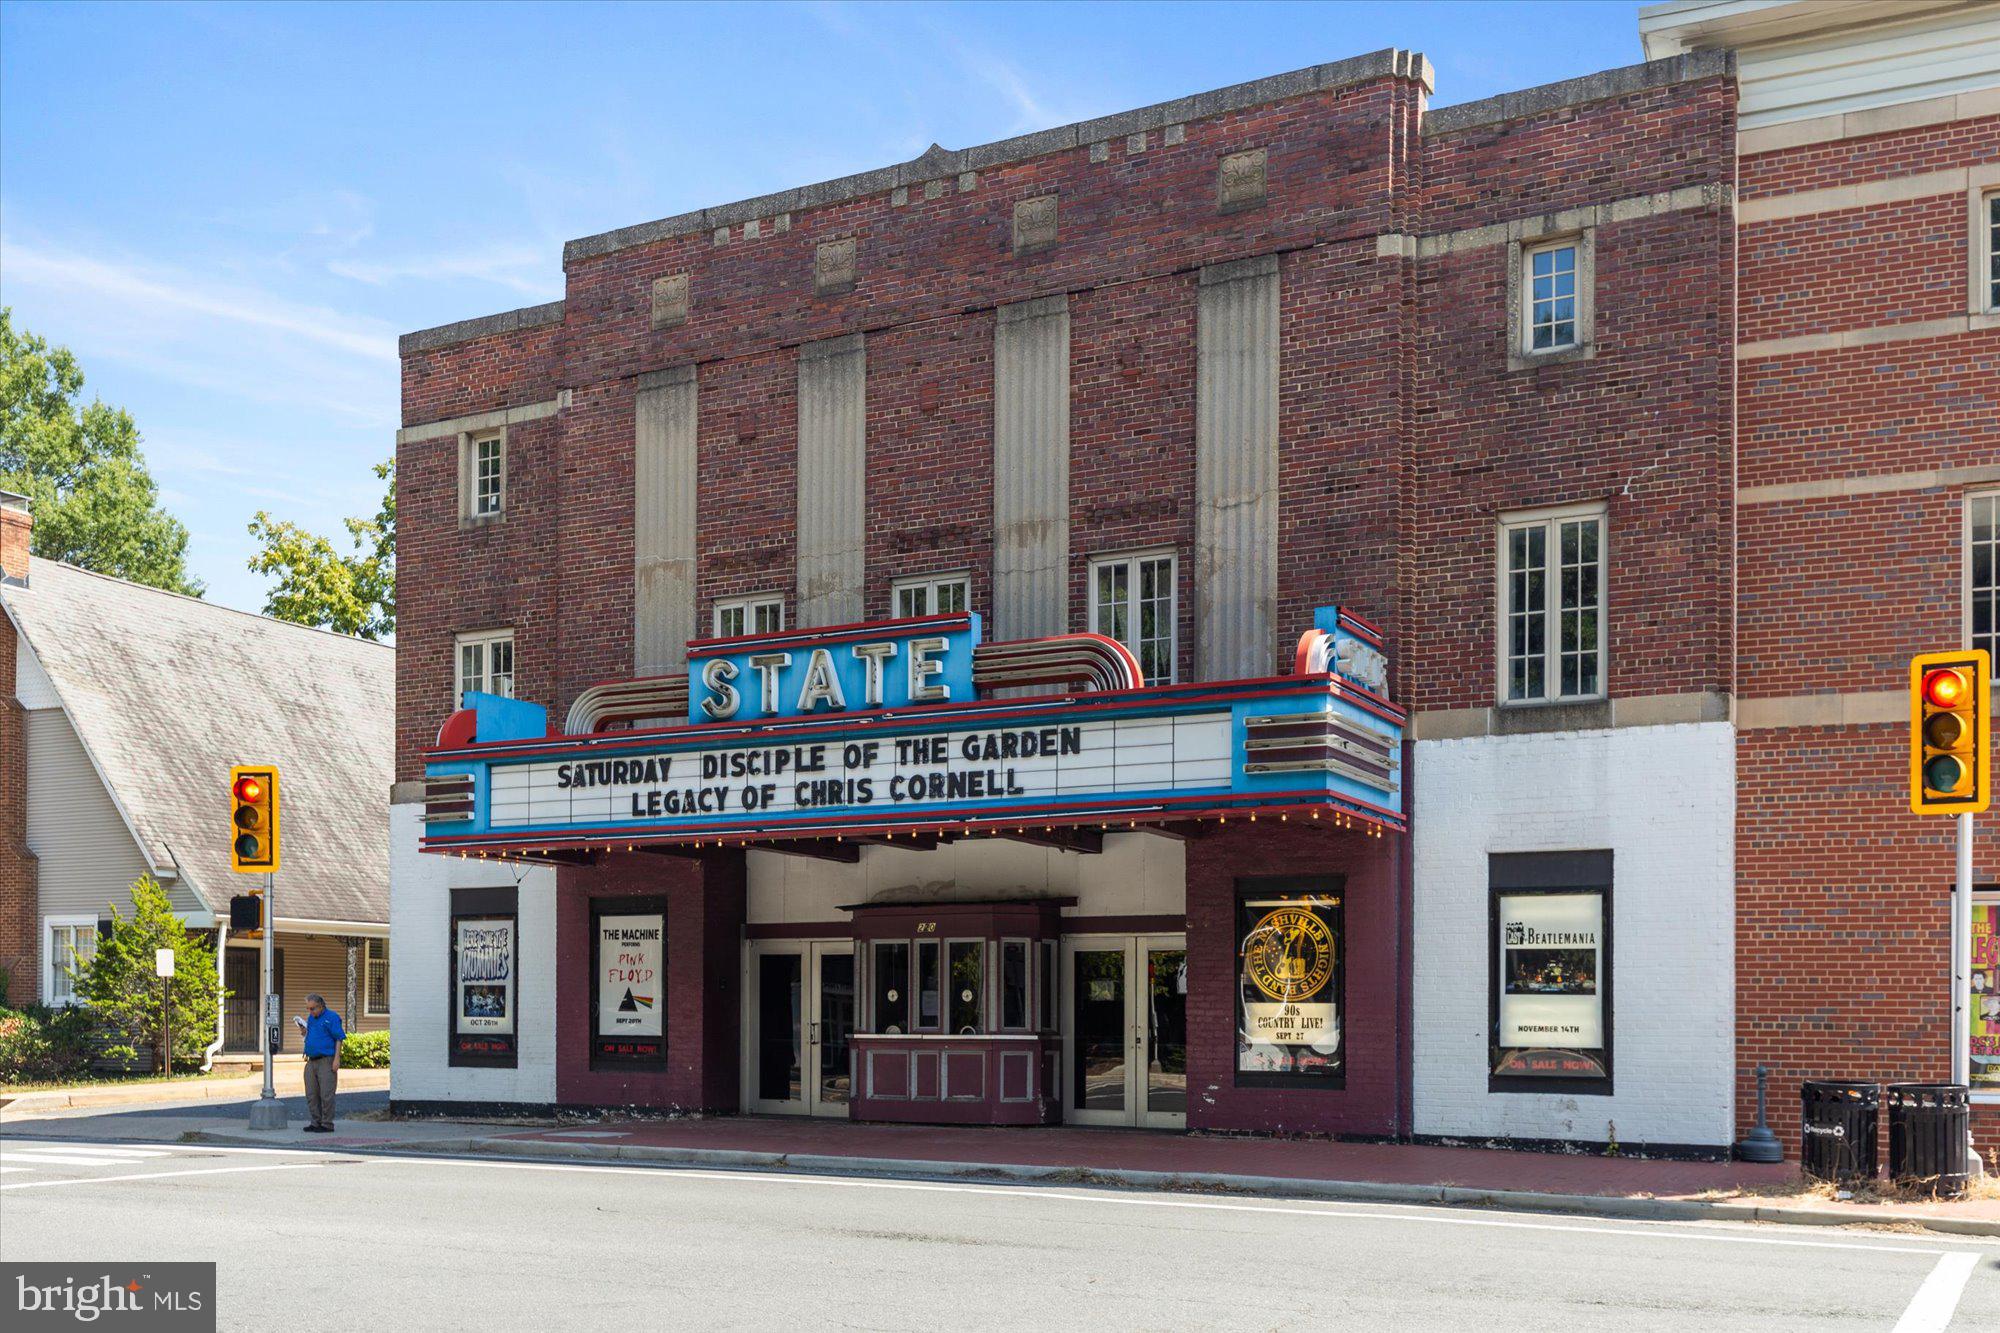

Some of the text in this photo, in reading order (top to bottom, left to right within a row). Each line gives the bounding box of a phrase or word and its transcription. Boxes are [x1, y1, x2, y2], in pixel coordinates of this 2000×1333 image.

[701, 637, 950, 719] STATE
[558, 727, 1080, 788] SATURDAY DISCIPLE OF THE GARDEN
[632, 768, 1024, 816] LEGACY OF CHRIS CORNELL
[603, 929, 660, 940] THE MACHINE
[619, 953, 645, 965] PINK
[1301, 943, 1329, 991] NIGHTS
[608, 968, 653, 984] FLOYD
[1284, 1004, 1301, 1016] 90s
[1258, 1016, 1323, 1029] COUNTRY LIVE!
[1517, 1025, 1579, 1033] NOVEMBER 14TH
[1276, 1032, 1304, 1040] SEPT 27
[1531, 1060, 1556, 1070] SALE
